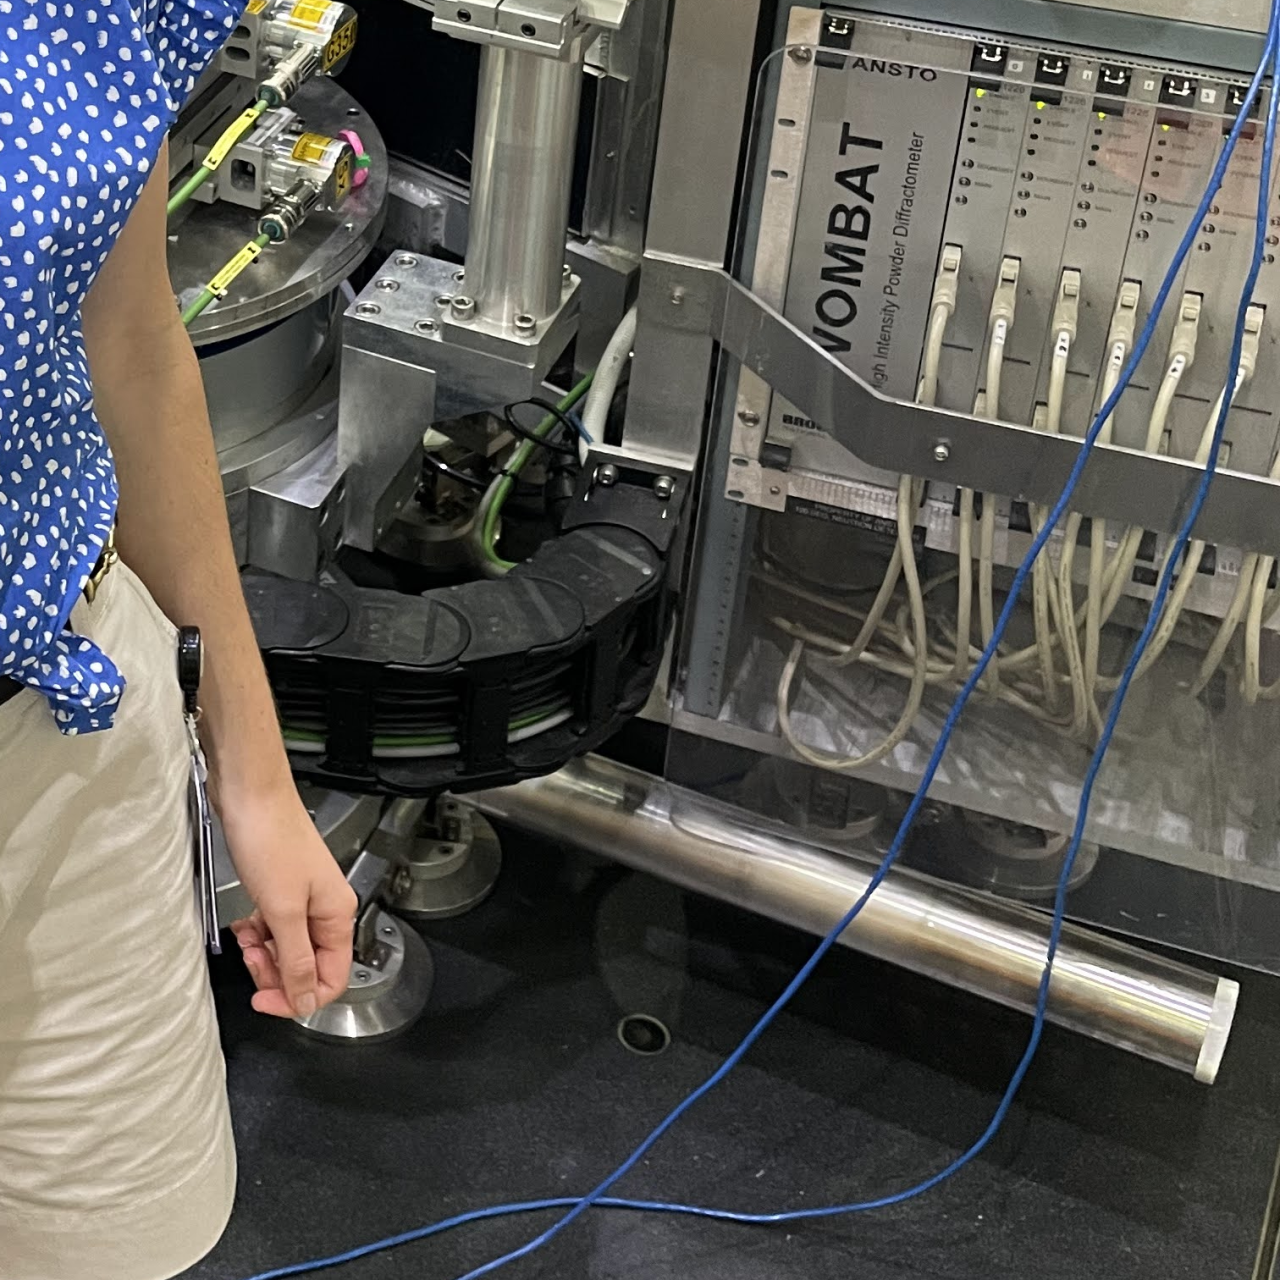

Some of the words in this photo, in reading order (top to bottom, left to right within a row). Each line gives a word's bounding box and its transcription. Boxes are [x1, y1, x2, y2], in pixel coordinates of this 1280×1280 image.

[852, 57, 937, 82] ANSTO
[892, 131, 925, 237] Diffractometer
[883, 241, 906, 297] Powder
[873, 300, 900, 360] Intensity
[872, 363, 888, 389] igh
